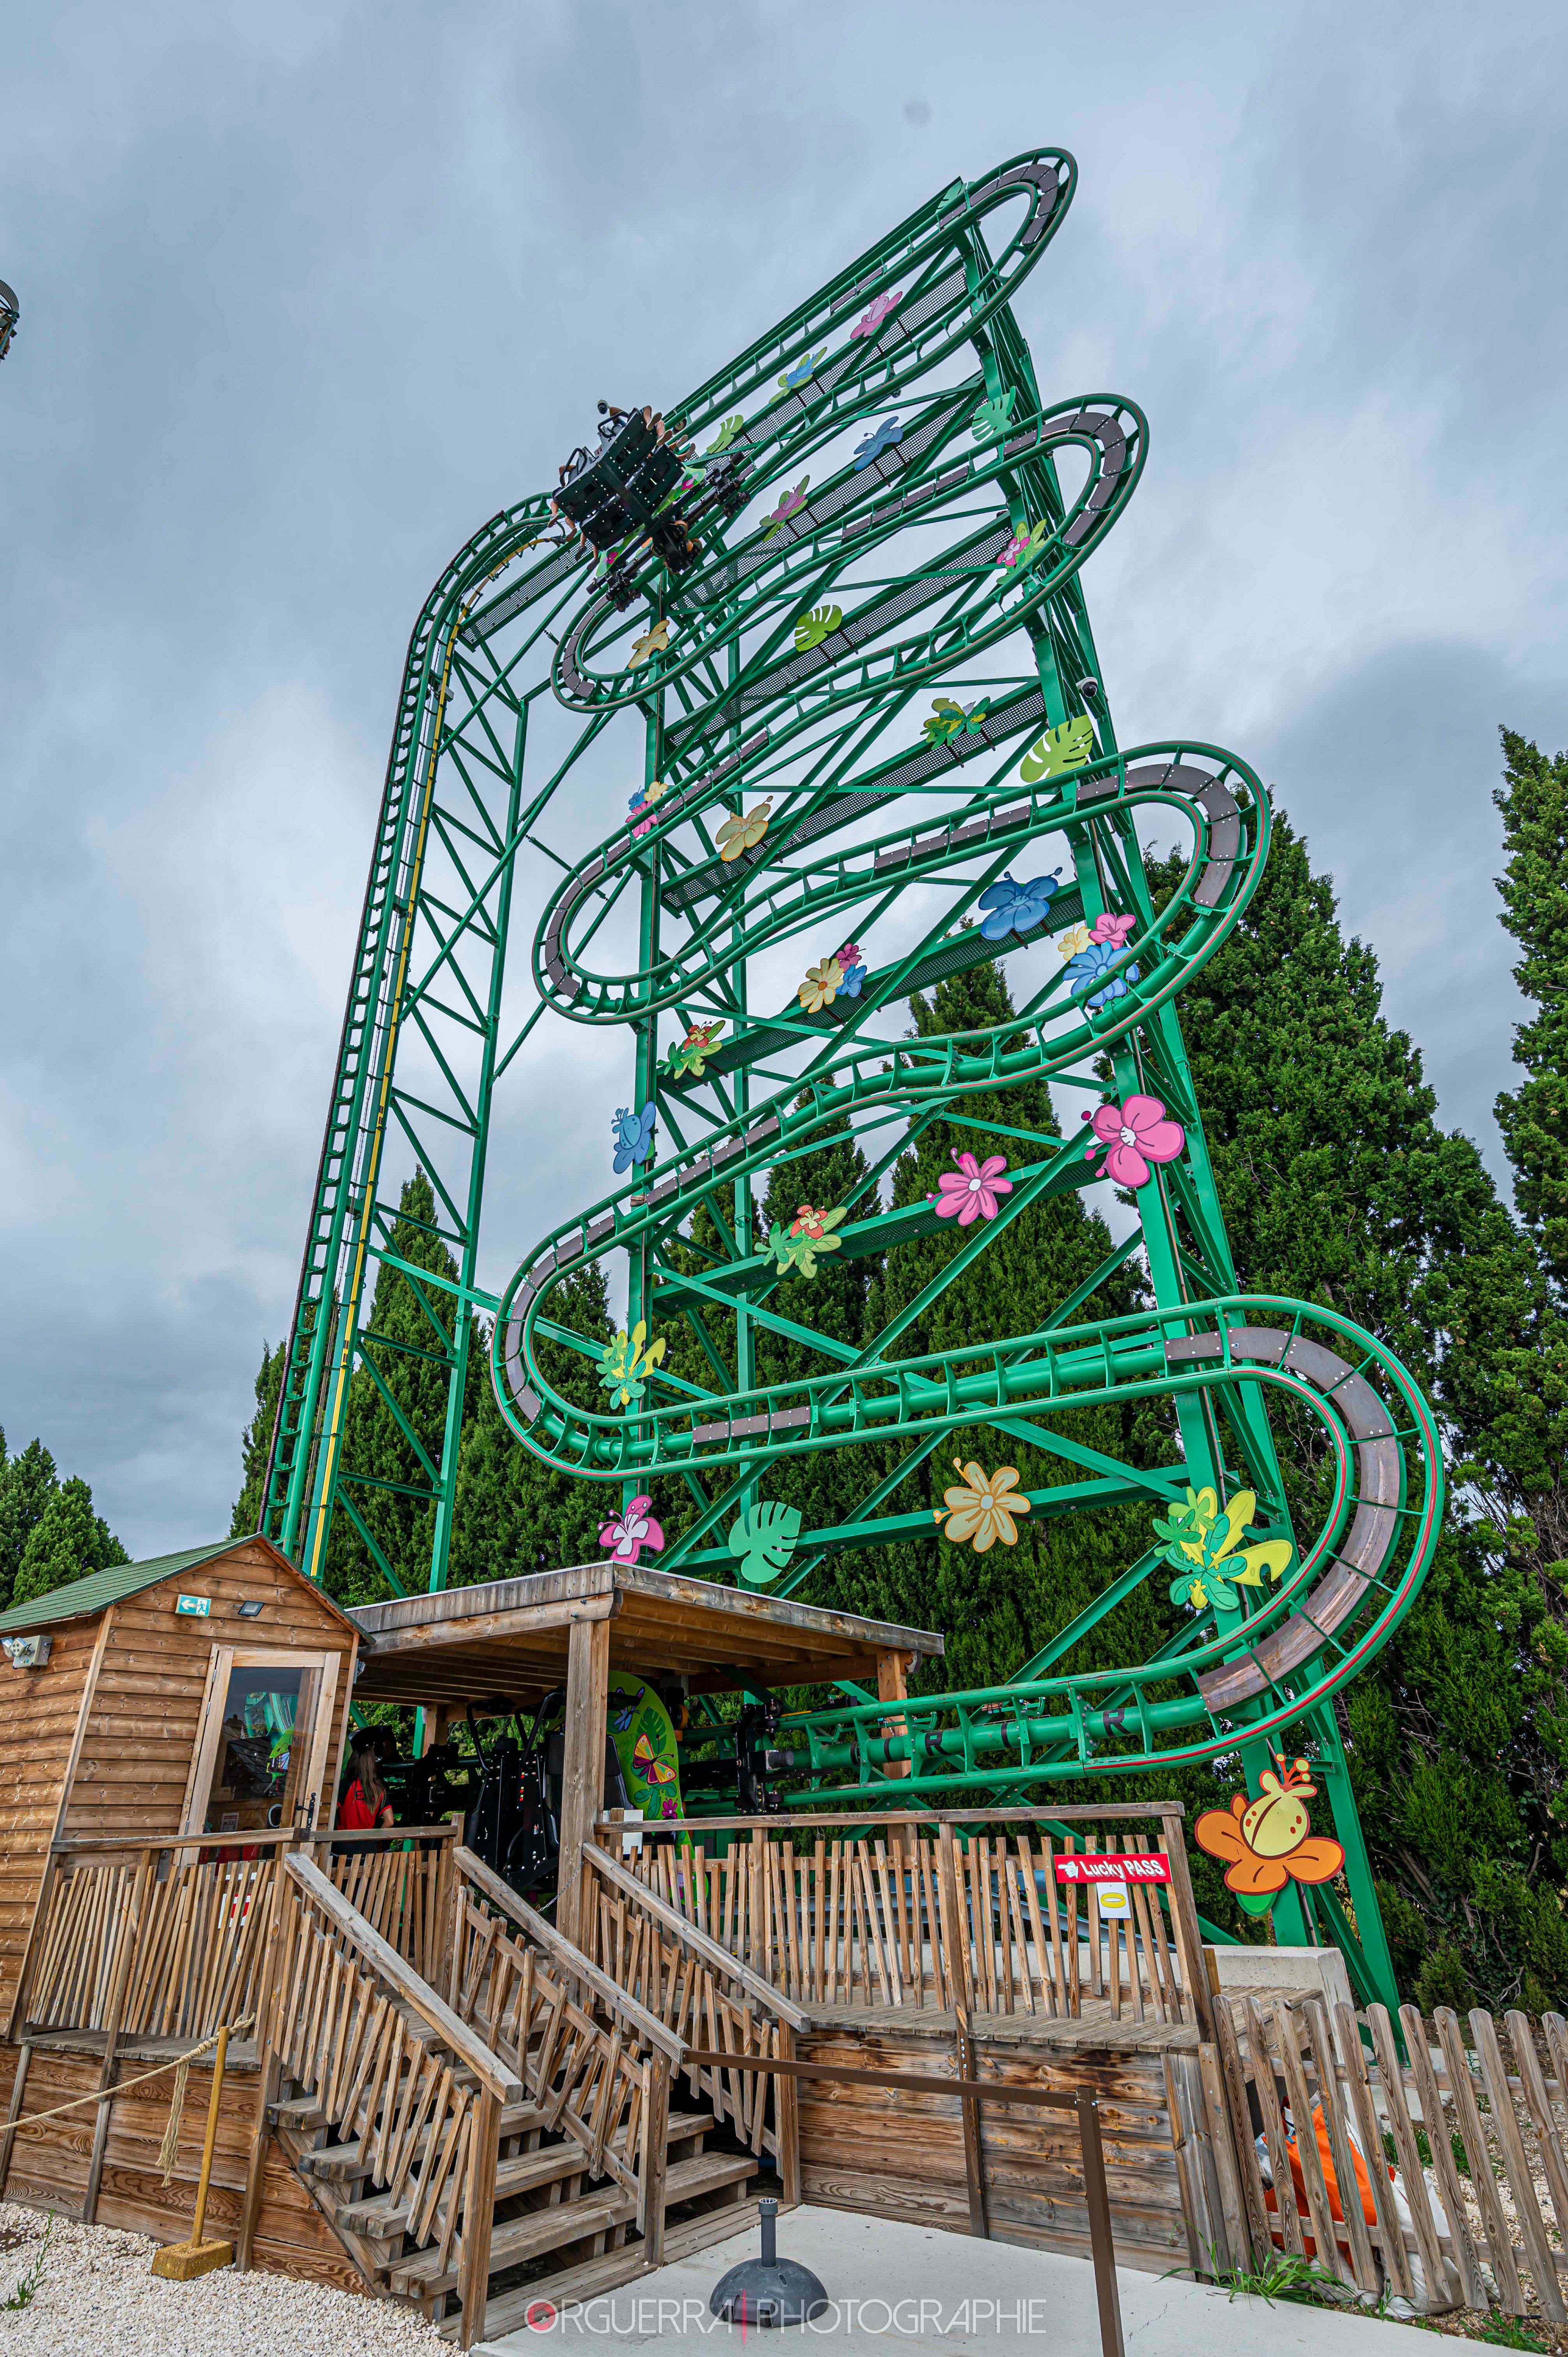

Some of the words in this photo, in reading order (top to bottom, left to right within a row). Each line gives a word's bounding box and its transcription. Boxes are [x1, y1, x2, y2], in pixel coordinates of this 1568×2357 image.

[1103, 1708, 1131, 1737] R
[924, 1732, 953, 1756] R
[1079, 1860, 1126, 1880] Lucky
[1123, 1860, 1165, 1876] PASS
